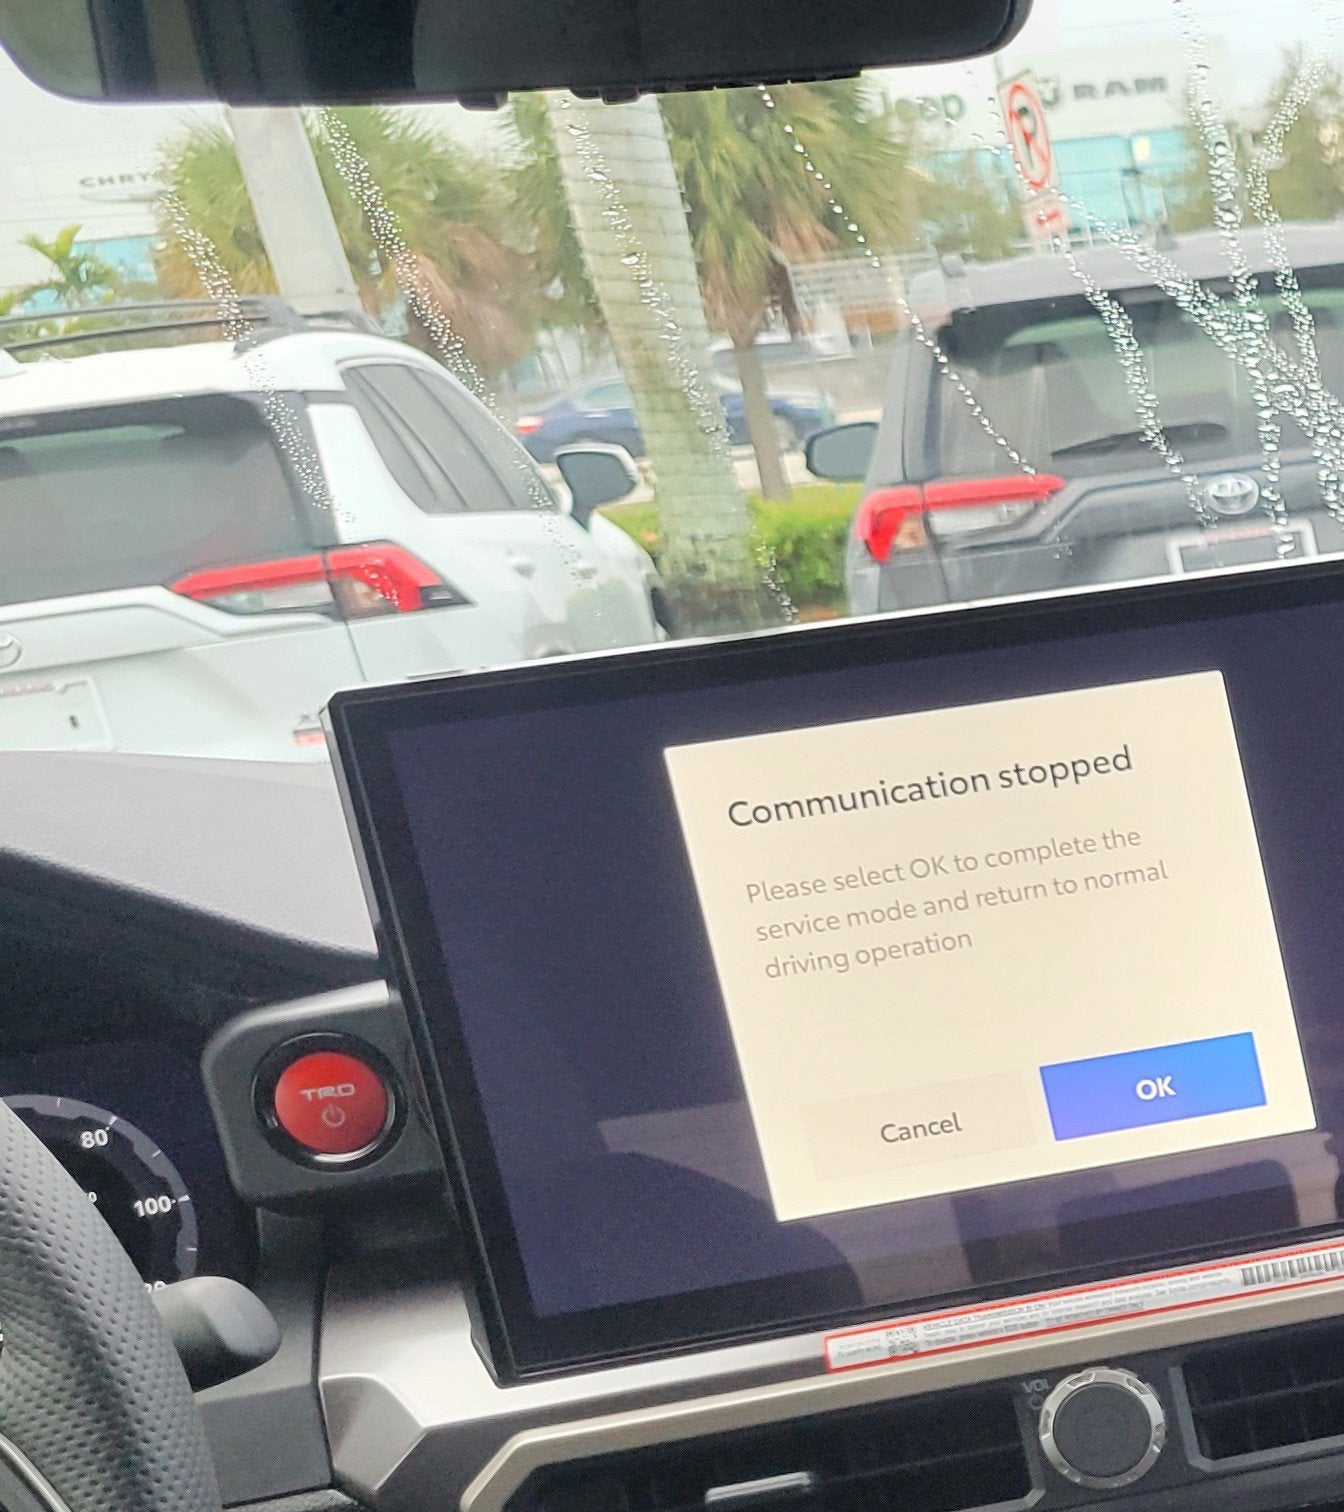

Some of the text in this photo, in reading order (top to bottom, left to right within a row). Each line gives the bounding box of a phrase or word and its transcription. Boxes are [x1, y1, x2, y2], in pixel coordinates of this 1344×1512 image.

[1073, 76, 1168, 98] RAM
[727, 745, 1134, 828] Communication stopped
[746, 827, 1142, 905] Please select OK to complete the
[756, 859, 1170, 943] service mode and return to normal
[765, 929, 974, 980] driving operation
[299, 1083, 356, 1102] TRD
[1135, 1074, 1177, 1102] OK
[80, 1128, 109, 1149] 80
[880, 1112, 963, 1144] Cancel
[133, 1195, 172, 1218] 100
[1022, 1378, 1050, 1394] VOL
